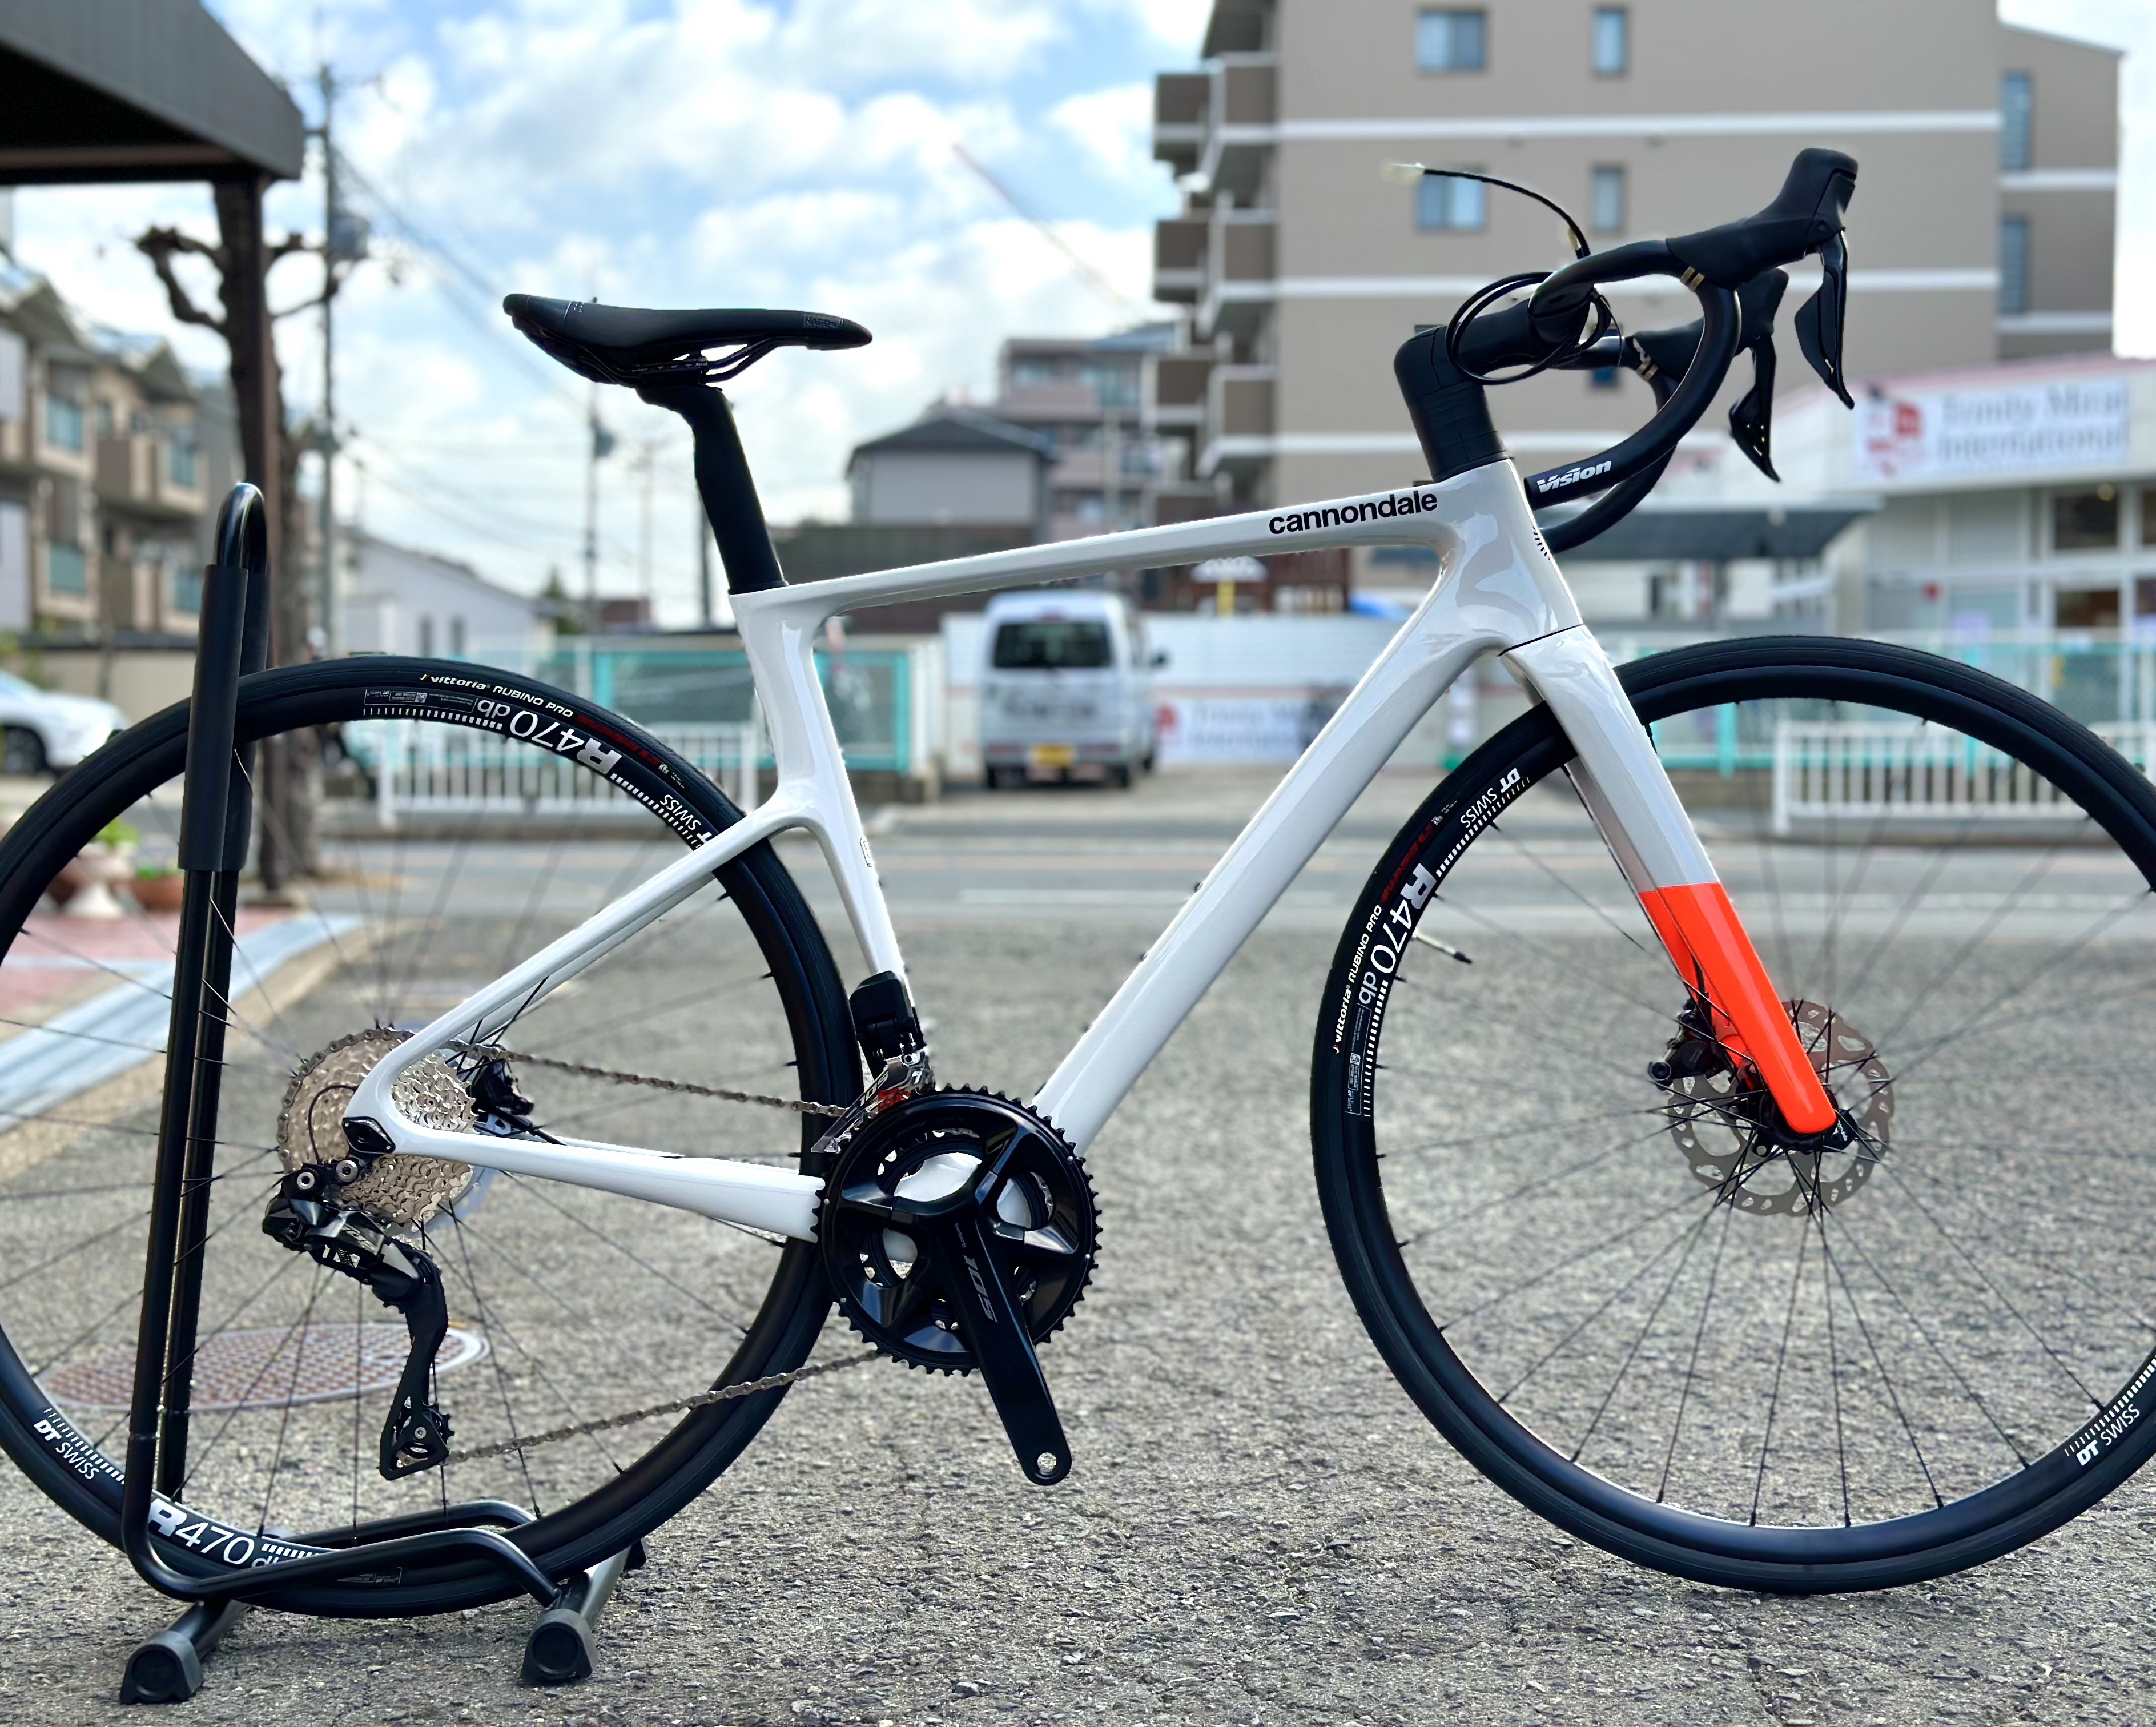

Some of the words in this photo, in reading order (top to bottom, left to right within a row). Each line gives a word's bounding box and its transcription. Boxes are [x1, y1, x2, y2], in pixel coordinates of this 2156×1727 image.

[1536, 460, 1611, 493] Vision
[1269, 490, 1438, 535] cannondale
[477, 700, 511, 718] db
[492, 685, 544, 705] RUBINO
[545, 702, 574, 717] PRO
[510, 710, 622, 774] R470
[1500, 768, 1521, 793] DT
[659, 794, 701, 830] SWISS
[1460, 788, 1497, 828] SWISS
[1370, 863, 1437, 974] R470
[1348, 933, 1370, 983] RUBINO
[1366, 905, 1382, 933] PRO
[1358, 971, 1377, 1005] db
[859, 1070, 888, 1107] 105
[963, 1255, 998, 1323] 105
[33, 1419, 62, 1441] DT
[55, 1442, 100, 1480] SWISS
[2076, 1439, 2098, 1466] DT
[2100, 1403, 2140, 1446] SWISS
[148, 1498, 255, 1565] R470
